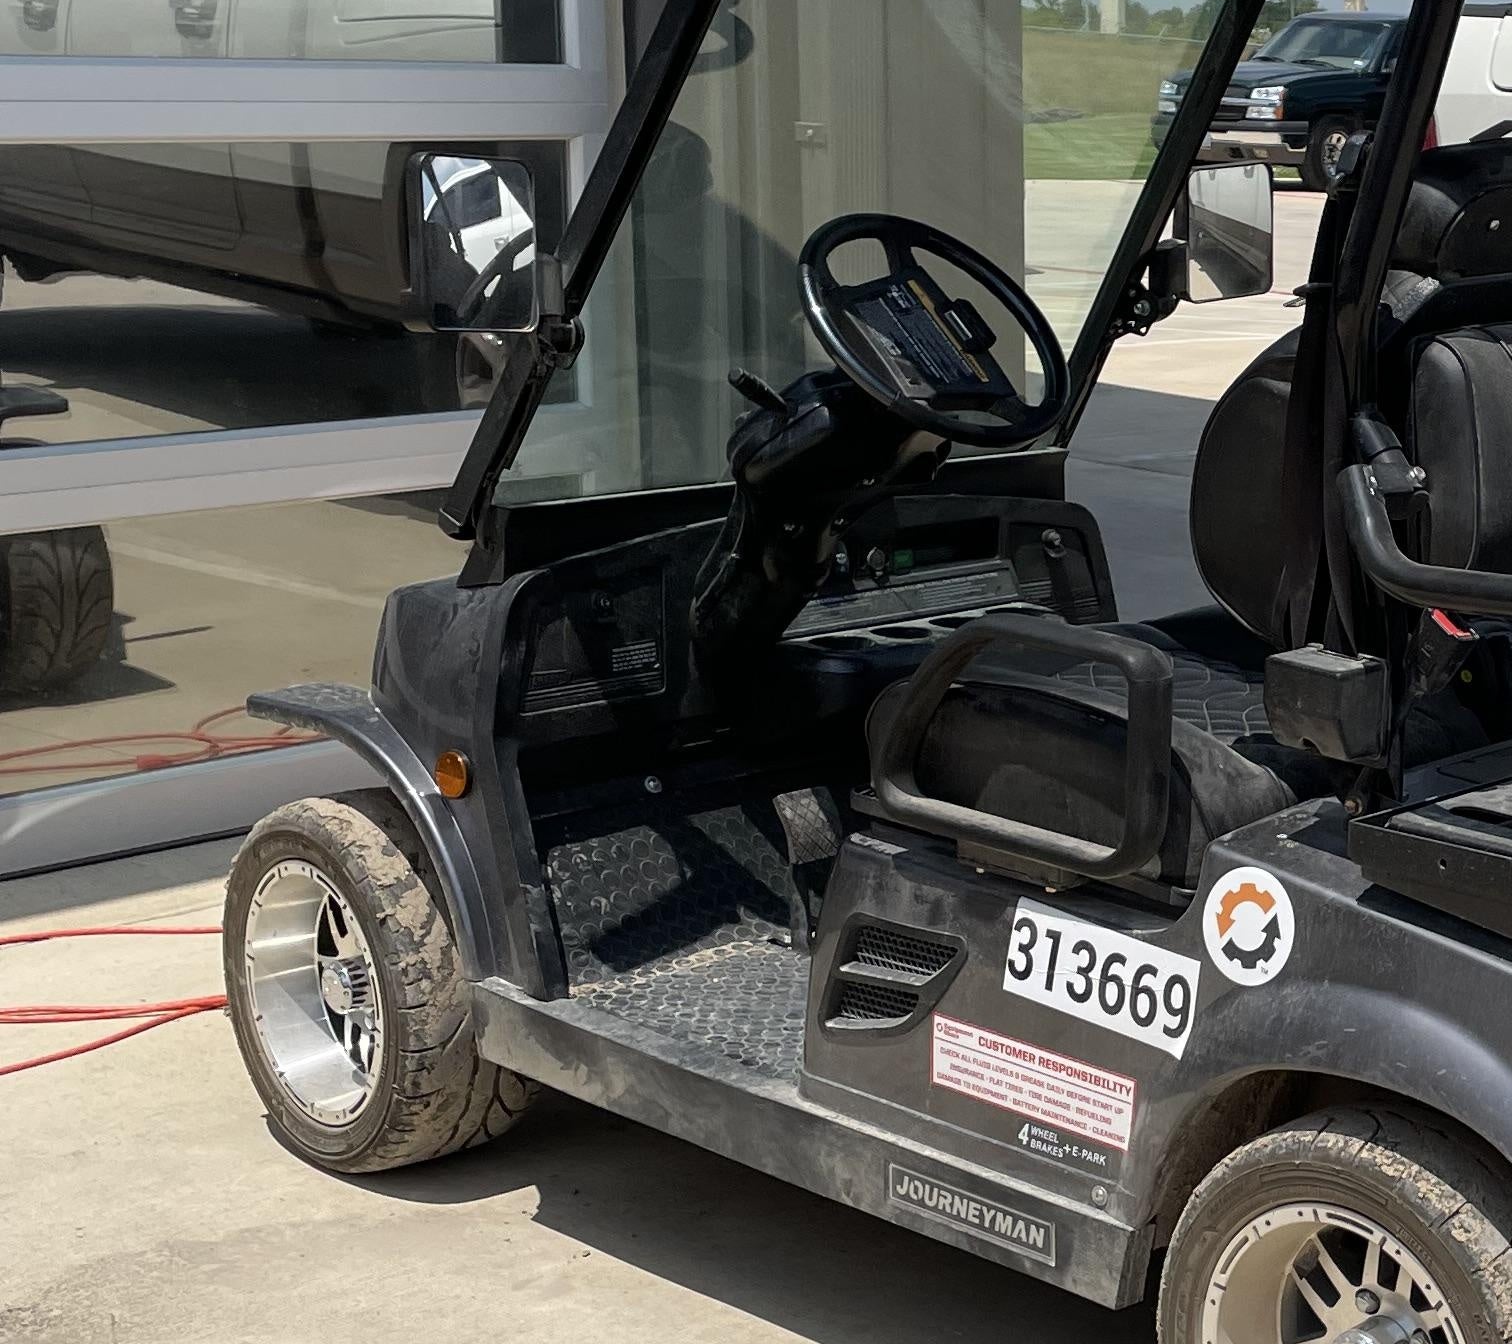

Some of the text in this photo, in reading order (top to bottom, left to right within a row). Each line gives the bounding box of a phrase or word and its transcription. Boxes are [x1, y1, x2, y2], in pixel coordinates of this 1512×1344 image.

[1008, 917, 1192, 1039] 313669
[940, 1046, 959, 1059] CHECK
[961, 1053, 971, 1063] ALL
[1066, 1089, 1091, 1104] BEFORE
[1092, 1098, 1112, 1112] START
[1114, 1105, 1124, 1116] UP
[978, 1035, 1131, 1097] CUSTOMER RESPONSIBILITY
[989, 1076, 1002, 1087] FLAT
[1012, 1098, 1039, 1113] BATTERY
[1041, 1108, 1087, 1130] MAINTENANCE
[1092, 1125, 1125, 1143] CLEANING
[1018, 1123, 1059, 1145] 4 WHEEL
[1030, 1138, 1064, 1158] BRAKES
[896, 1175, 1045, 1249] JOURNEYMAN
